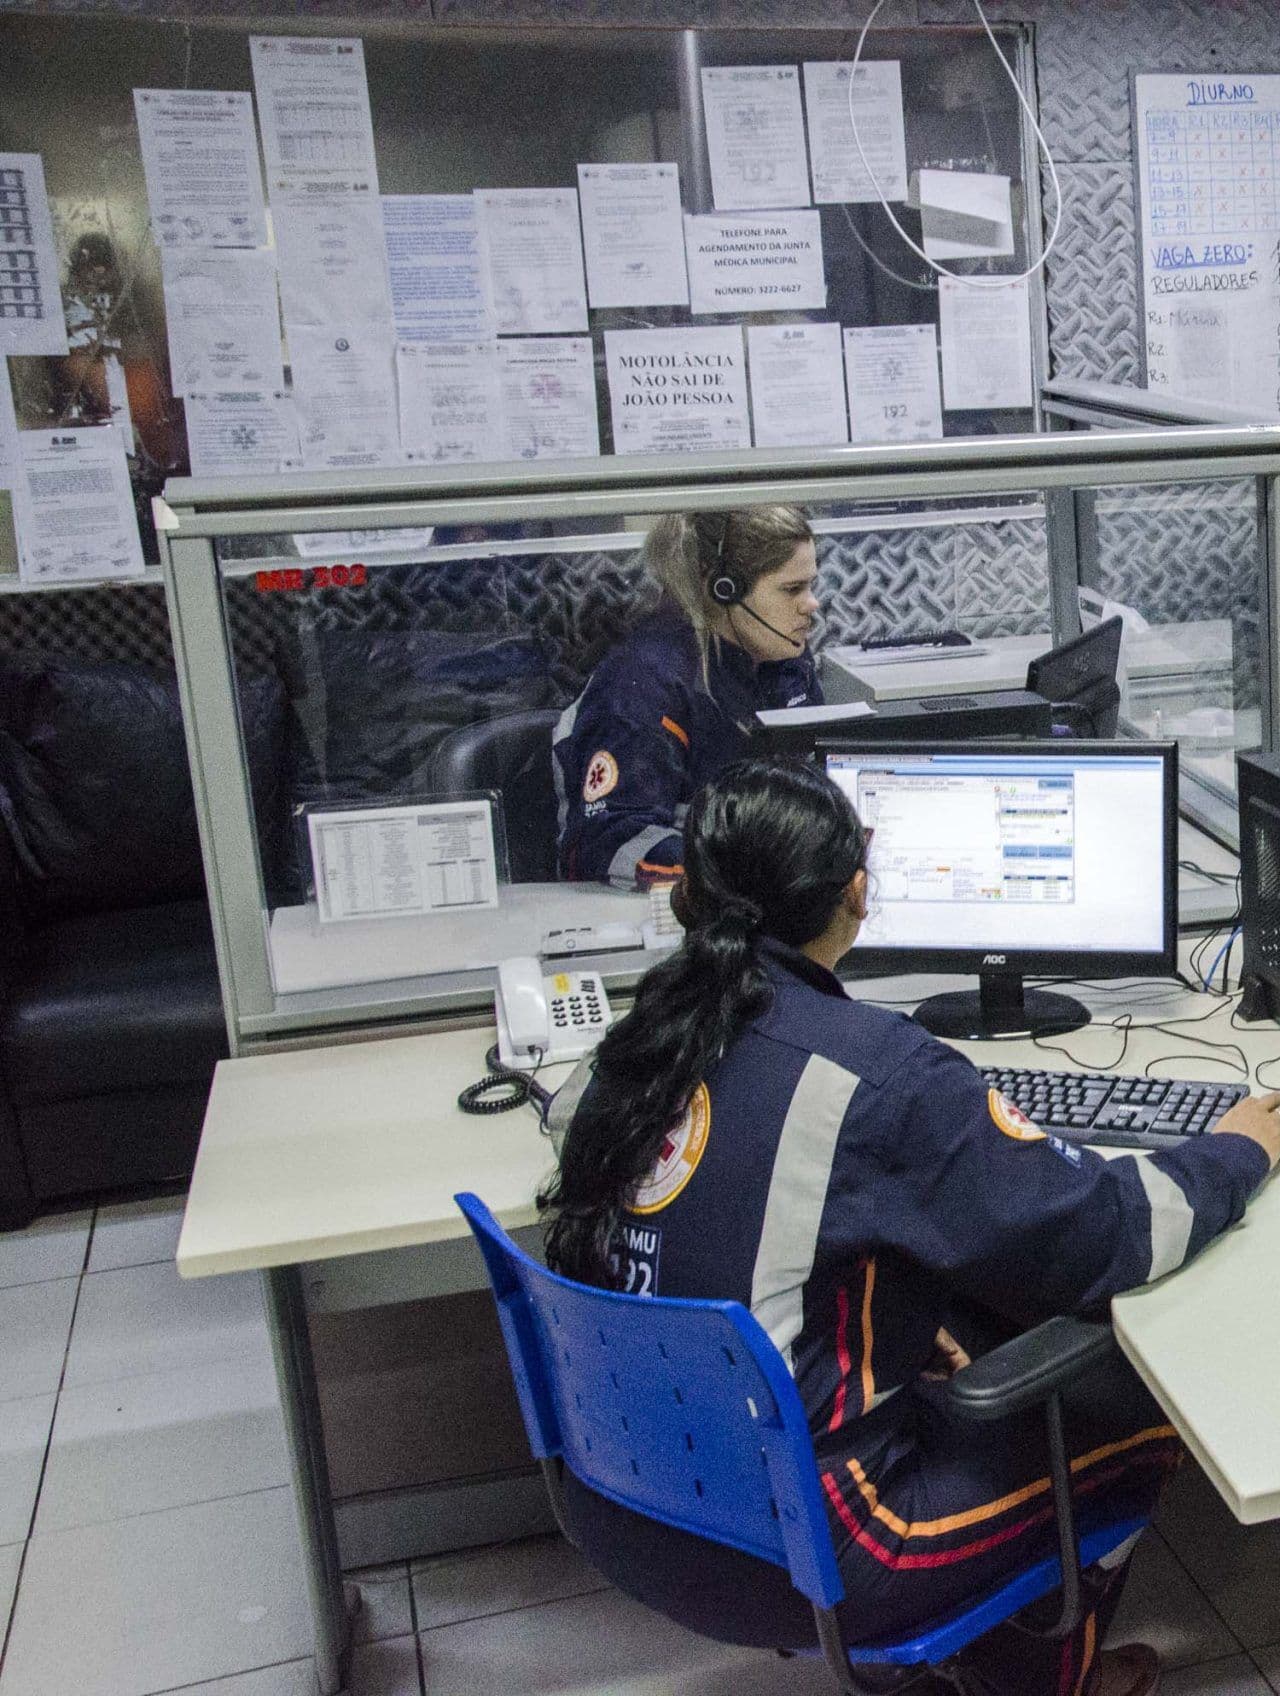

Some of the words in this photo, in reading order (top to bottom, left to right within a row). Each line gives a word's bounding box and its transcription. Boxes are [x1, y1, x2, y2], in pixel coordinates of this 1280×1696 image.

[721, 229, 764, 238] TELEFONE
[765, 228, 787, 237] PARA
[699, 242, 767, 253] AGENDAMENTO
[769, 242, 782, 250] DA
[784, 241, 811, 250] JUNTA
[750, 256, 798, 265] MUNICIPAL
[1150, 245, 1195, 268] VAGA
[1151, 271, 1258, 295] REGULADORES
[619, 352, 734, 368] MOTOLÂNCIA
[632, 371, 667, 387] NÃO
[671, 373, 697, 386] SAI
[703, 373, 724, 386] DE
[622, 390, 668, 406] JOÃO
[673, 392, 734, 405] PESSOA
[882, 404, 908, 419] 192
[256, 568, 304, 593] MR
[983, 954, 1006, 965] AOC
